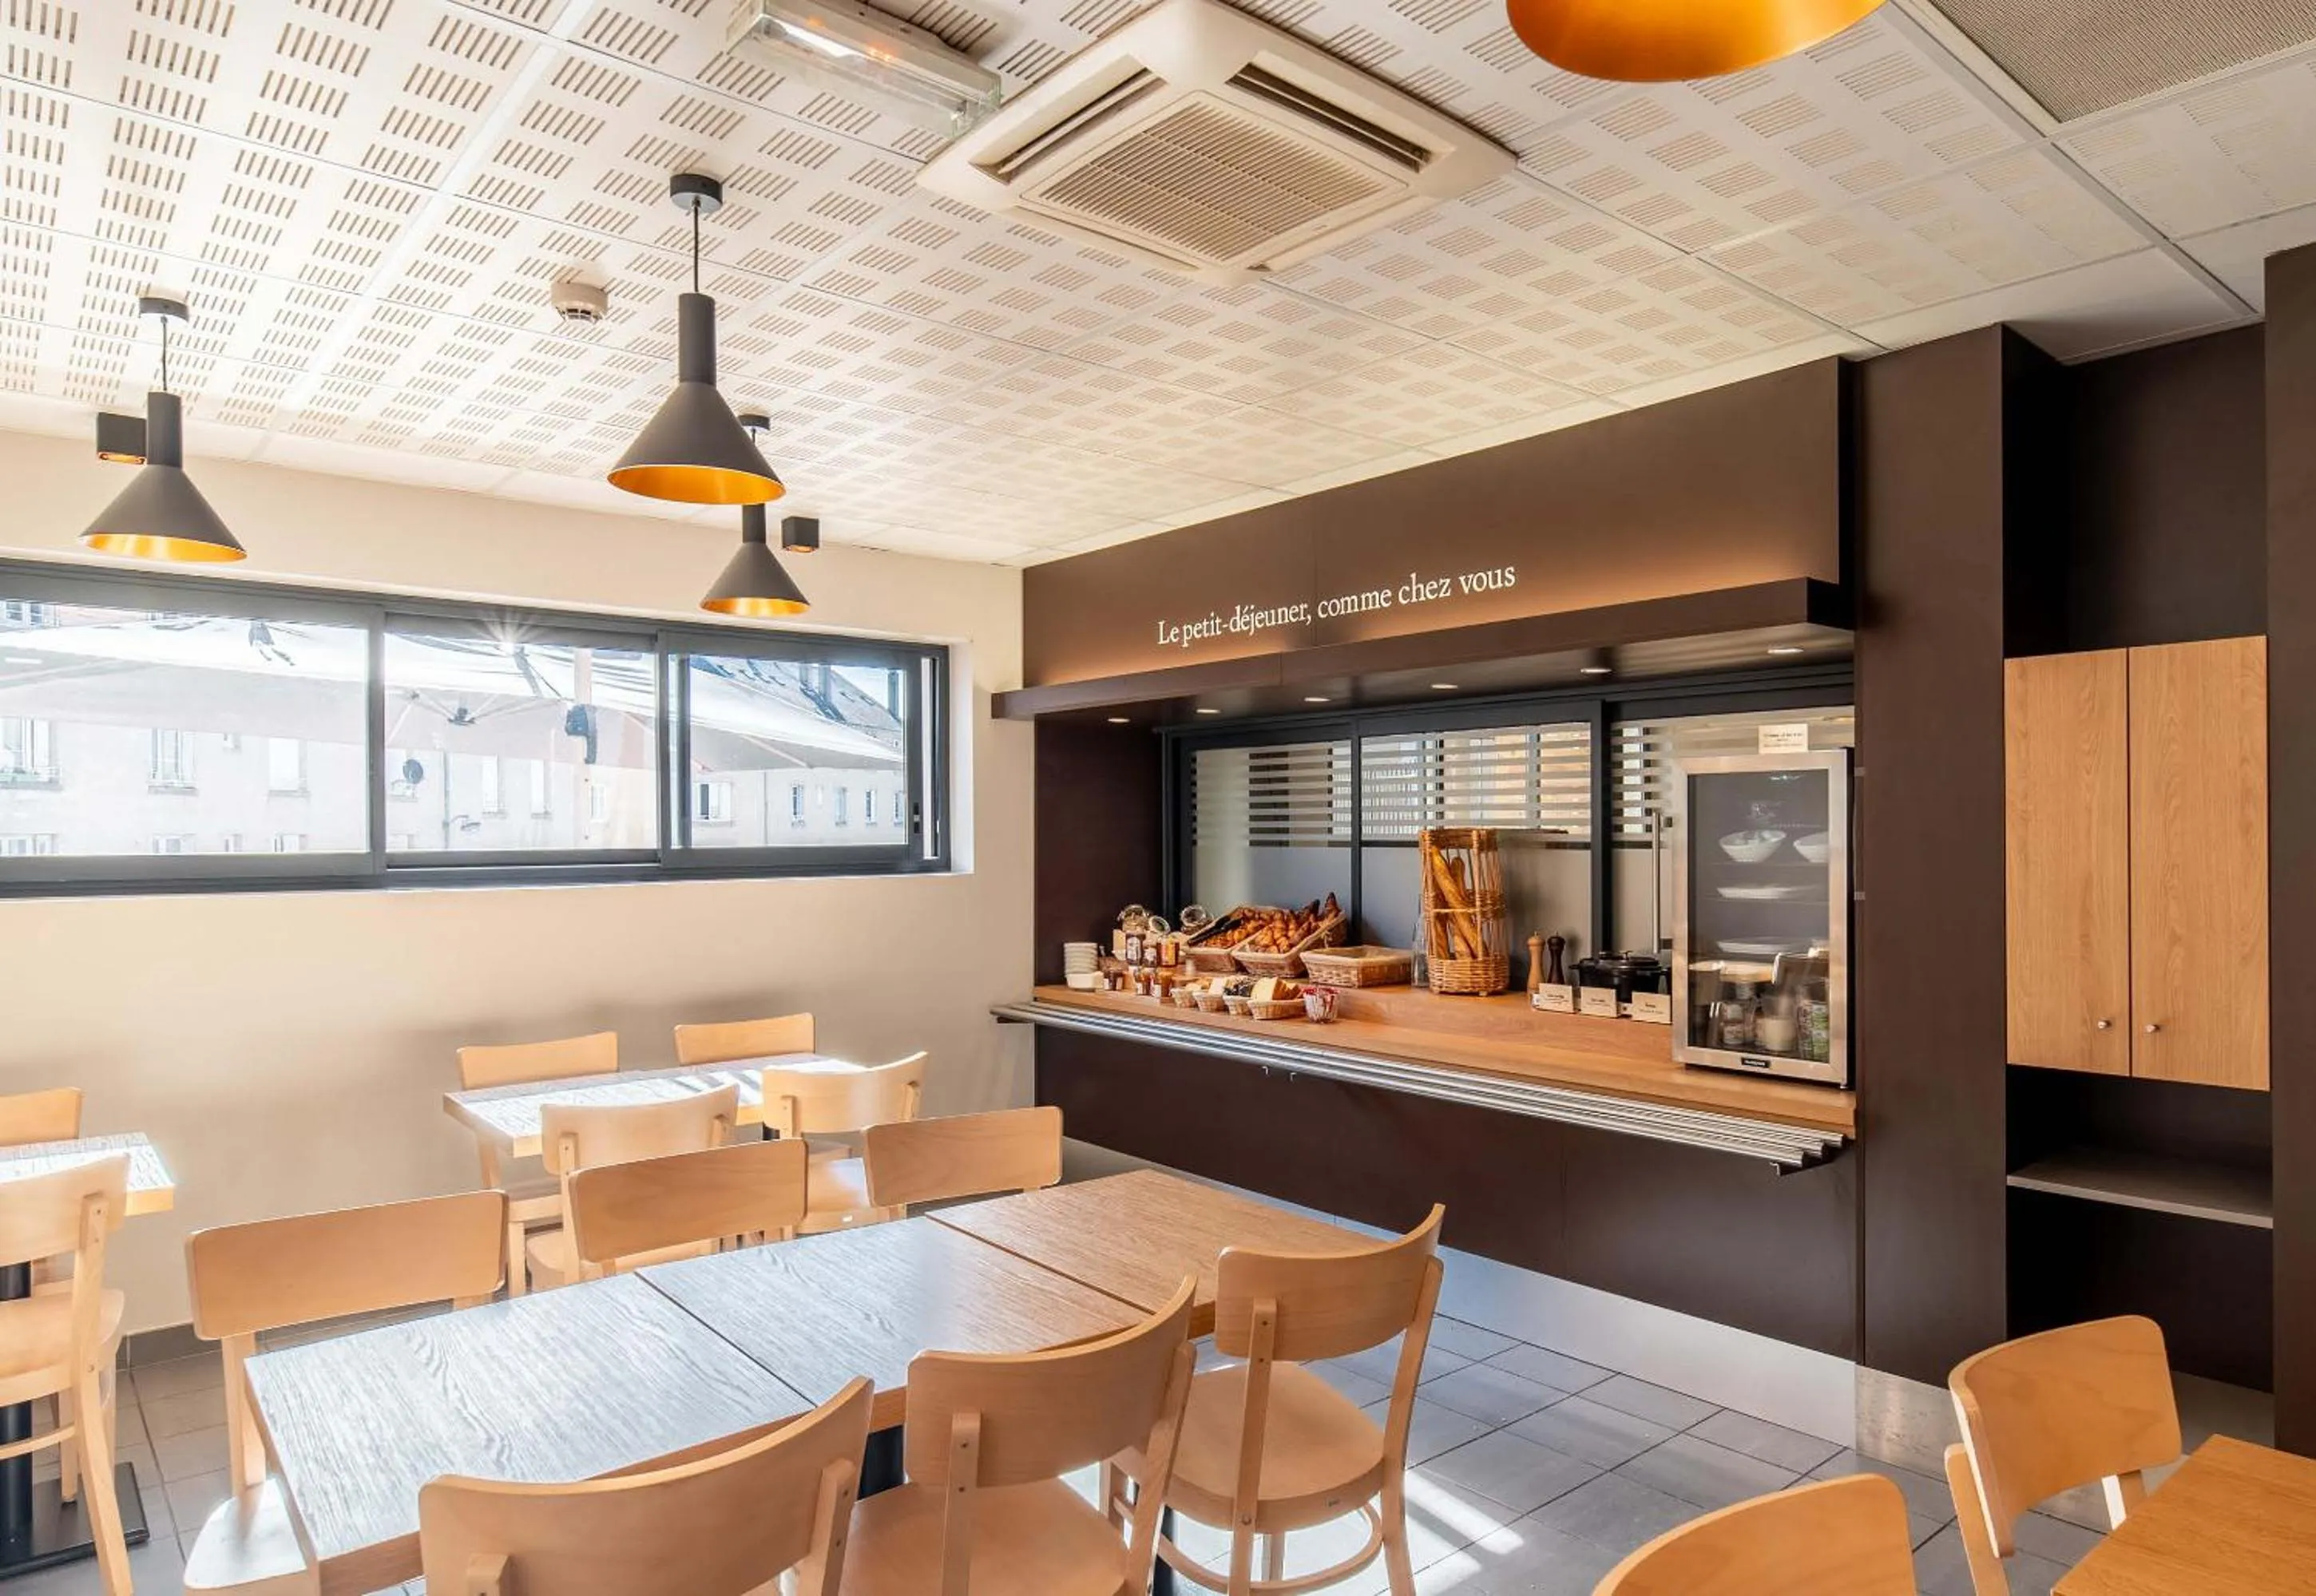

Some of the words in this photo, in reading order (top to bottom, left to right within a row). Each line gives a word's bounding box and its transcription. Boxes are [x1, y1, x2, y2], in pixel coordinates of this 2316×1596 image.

[1157, 620, 1180, 645] Le
[1181, 604, 1312, 648] petit-déjeuner,
[1317, 588, 1392, 619] comme
[1398, 572, 1452, 605] chez
[1458, 565, 1516, 594] vous
